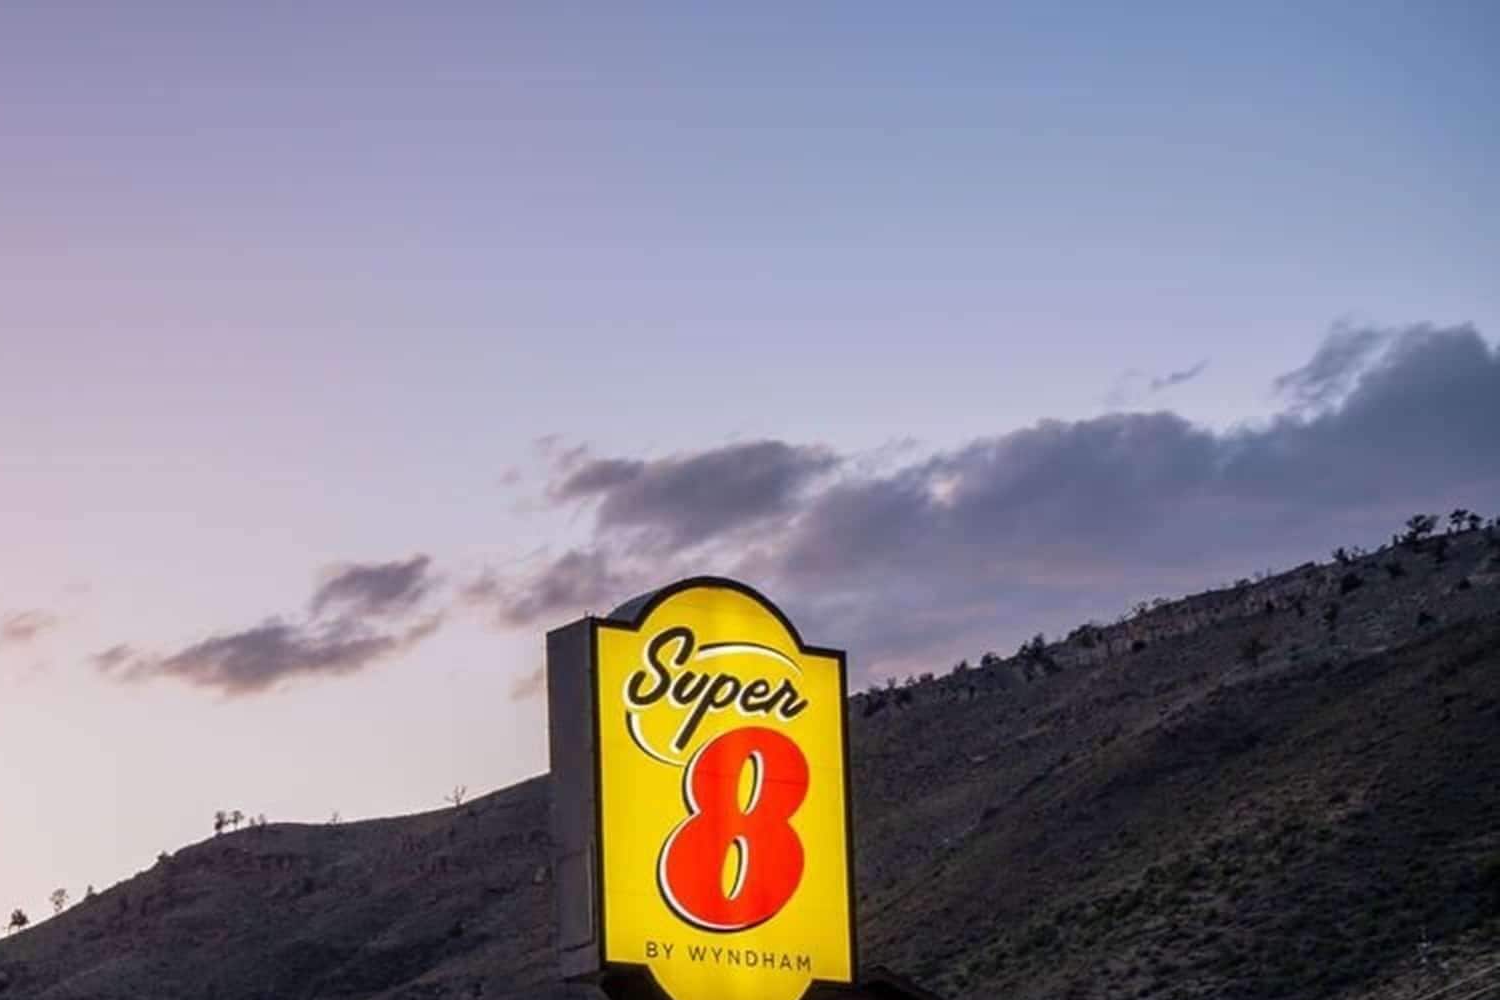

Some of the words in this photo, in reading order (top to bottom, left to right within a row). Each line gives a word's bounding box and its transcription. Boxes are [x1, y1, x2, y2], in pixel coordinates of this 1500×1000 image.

[627, 626, 809, 751] Super
[657, 726, 810, 933] 8
[646, 941, 674, 960] BY
[688, 945, 812, 972] WYNDHAM
